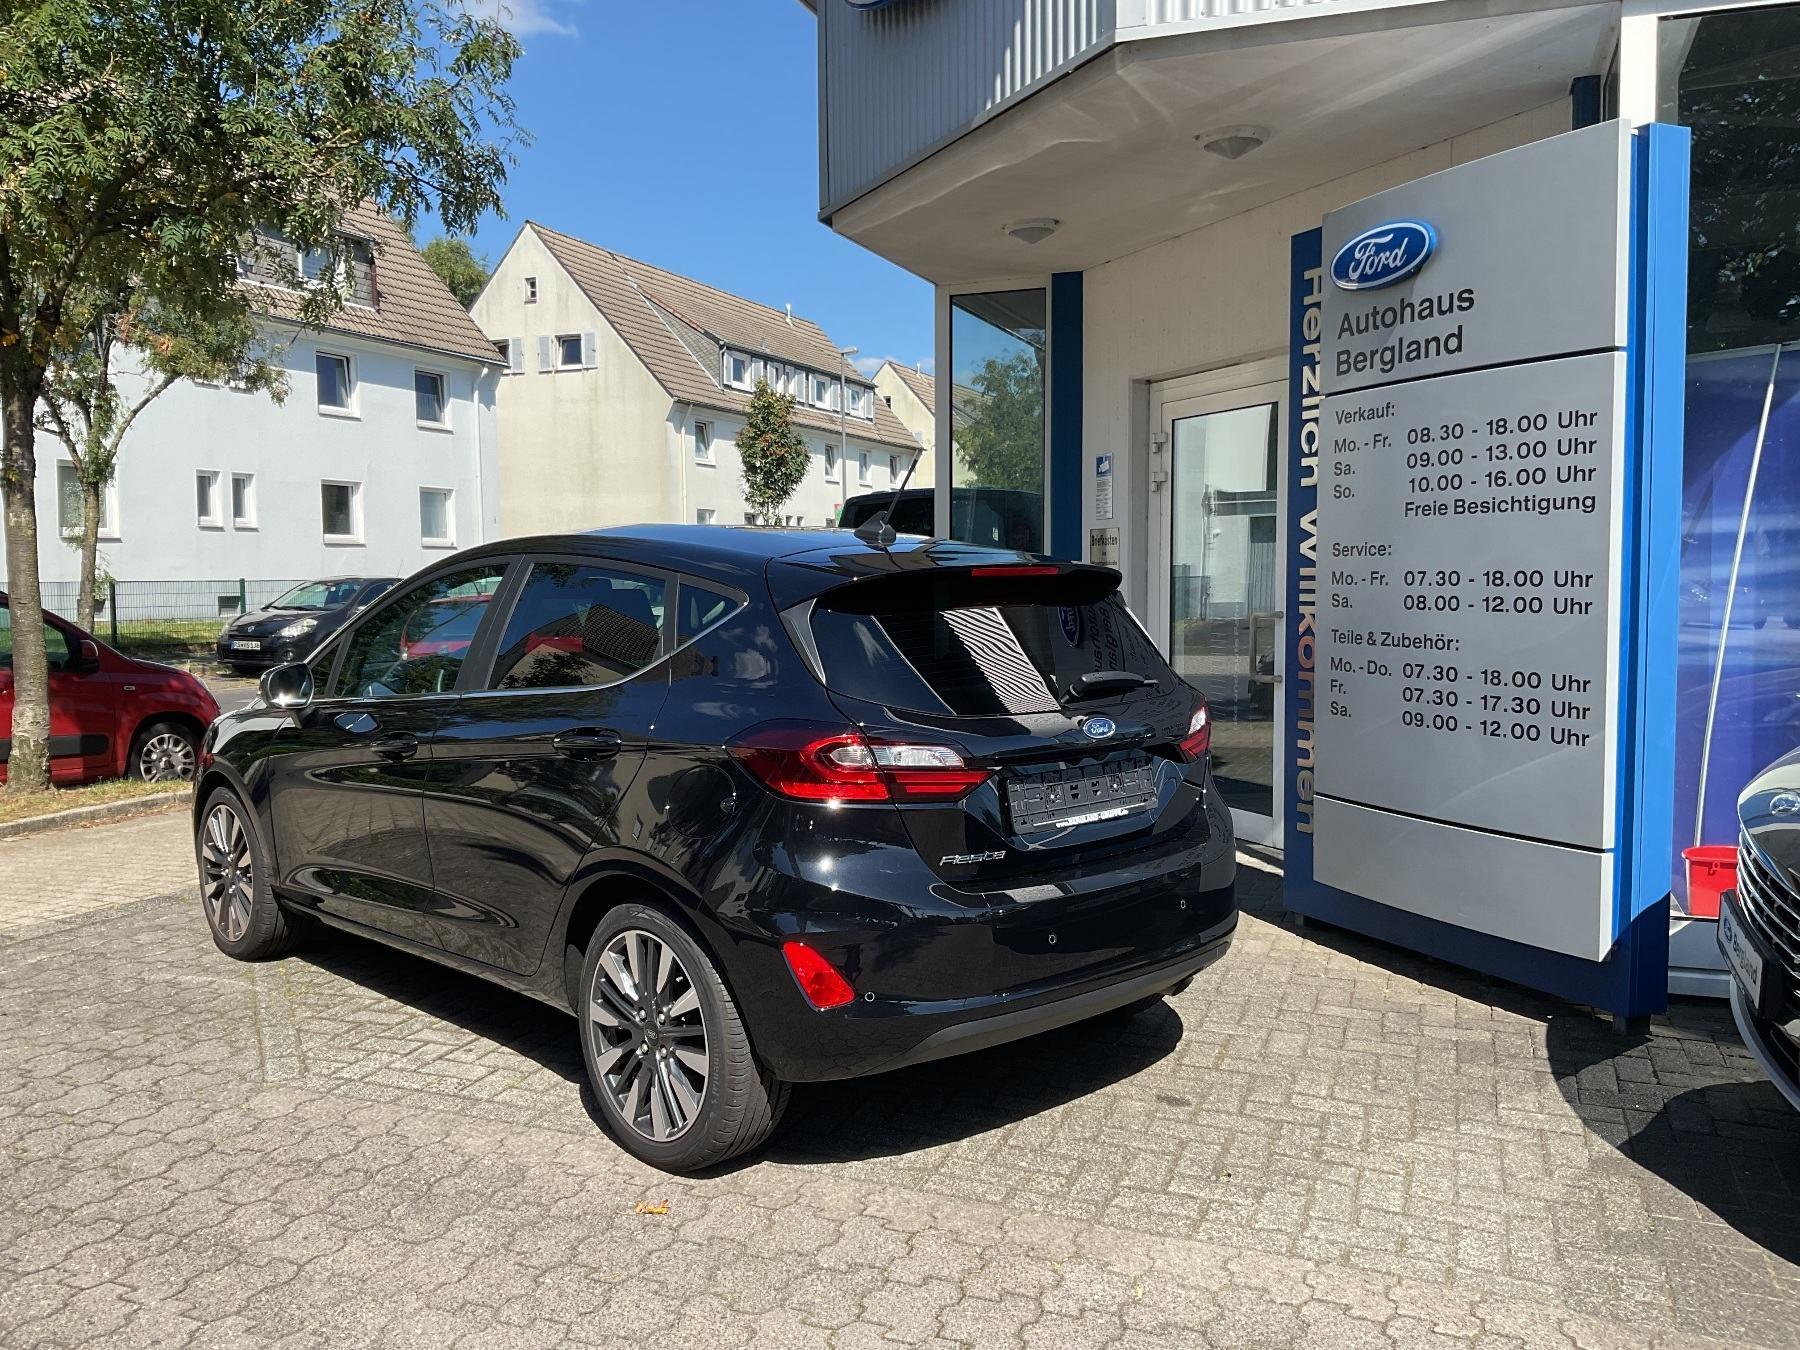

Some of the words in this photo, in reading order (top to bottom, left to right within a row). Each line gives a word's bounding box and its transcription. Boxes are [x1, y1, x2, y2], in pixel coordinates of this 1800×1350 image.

[1348, 234, 1407, 280] Ford
[1337, 287, 1475, 340] Autohaus
[1336, 325, 1464, 376] Bergland
[1336, 402, 1394, 424] Verkauf:
[1407, 425, 1463, 444] 08.30
[1486, 414, 1547, 435] 18.00
[1558, 410, 1599, 429] Uhr
[1334, 462, 1355, 476] Sa.
[1407, 449, 1463, 469] 09.00
[1486, 441, 1546, 461] 13.00
[1558, 438, 1597, 456] Uhr
[1334, 485, 1355, 499] So.
[1409, 474, 1462, 493] 10.00
[1485, 468, 1546, 488] 16.00
[1557, 465, 1596, 483] Uhr
[1405, 500, 1448, 517] Freie
[1454, 492, 1595, 516] Besichtigung
[1332, 542, 1391, 557] Service:
[1404, 569, 1461, 586] 07.30
[1483, 570, 1543, 587] 18.00
[1554, 570, 1593, 587] Uhr
[1332, 593, 1352, 608] Sa.
[1403, 593, 1460, 612] 08.00
[1482, 594, 1543, 615] 12.00
[1553, 597, 1592, 615] Uhr
[1331, 629, 1363, 645] Teile
[1367, 631, 1377, 646] &
[1379, 632, 1459, 651] Zubehör:
[1403, 663, 1458, 682] 07.30
[1481, 669, 1541, 689] 18.00
[1552, 674, 1591, 692] Uhr
[1331, 679, 1346, 694] Fr.
[1403, 687, 1458, 707] 07.30
[1480, 695, 1540, 715] 17.30
[1551, 701, 1592, 720] Uhr
[1331, 701, 1351, 717] Sa.
[1402, 711, 1457, 731] 09.00
[1480, 720, 1540, 743] 12.00
[1551, 727, 1590, 747] Uhr
[939, 850, 1007, 867] Fiesta
